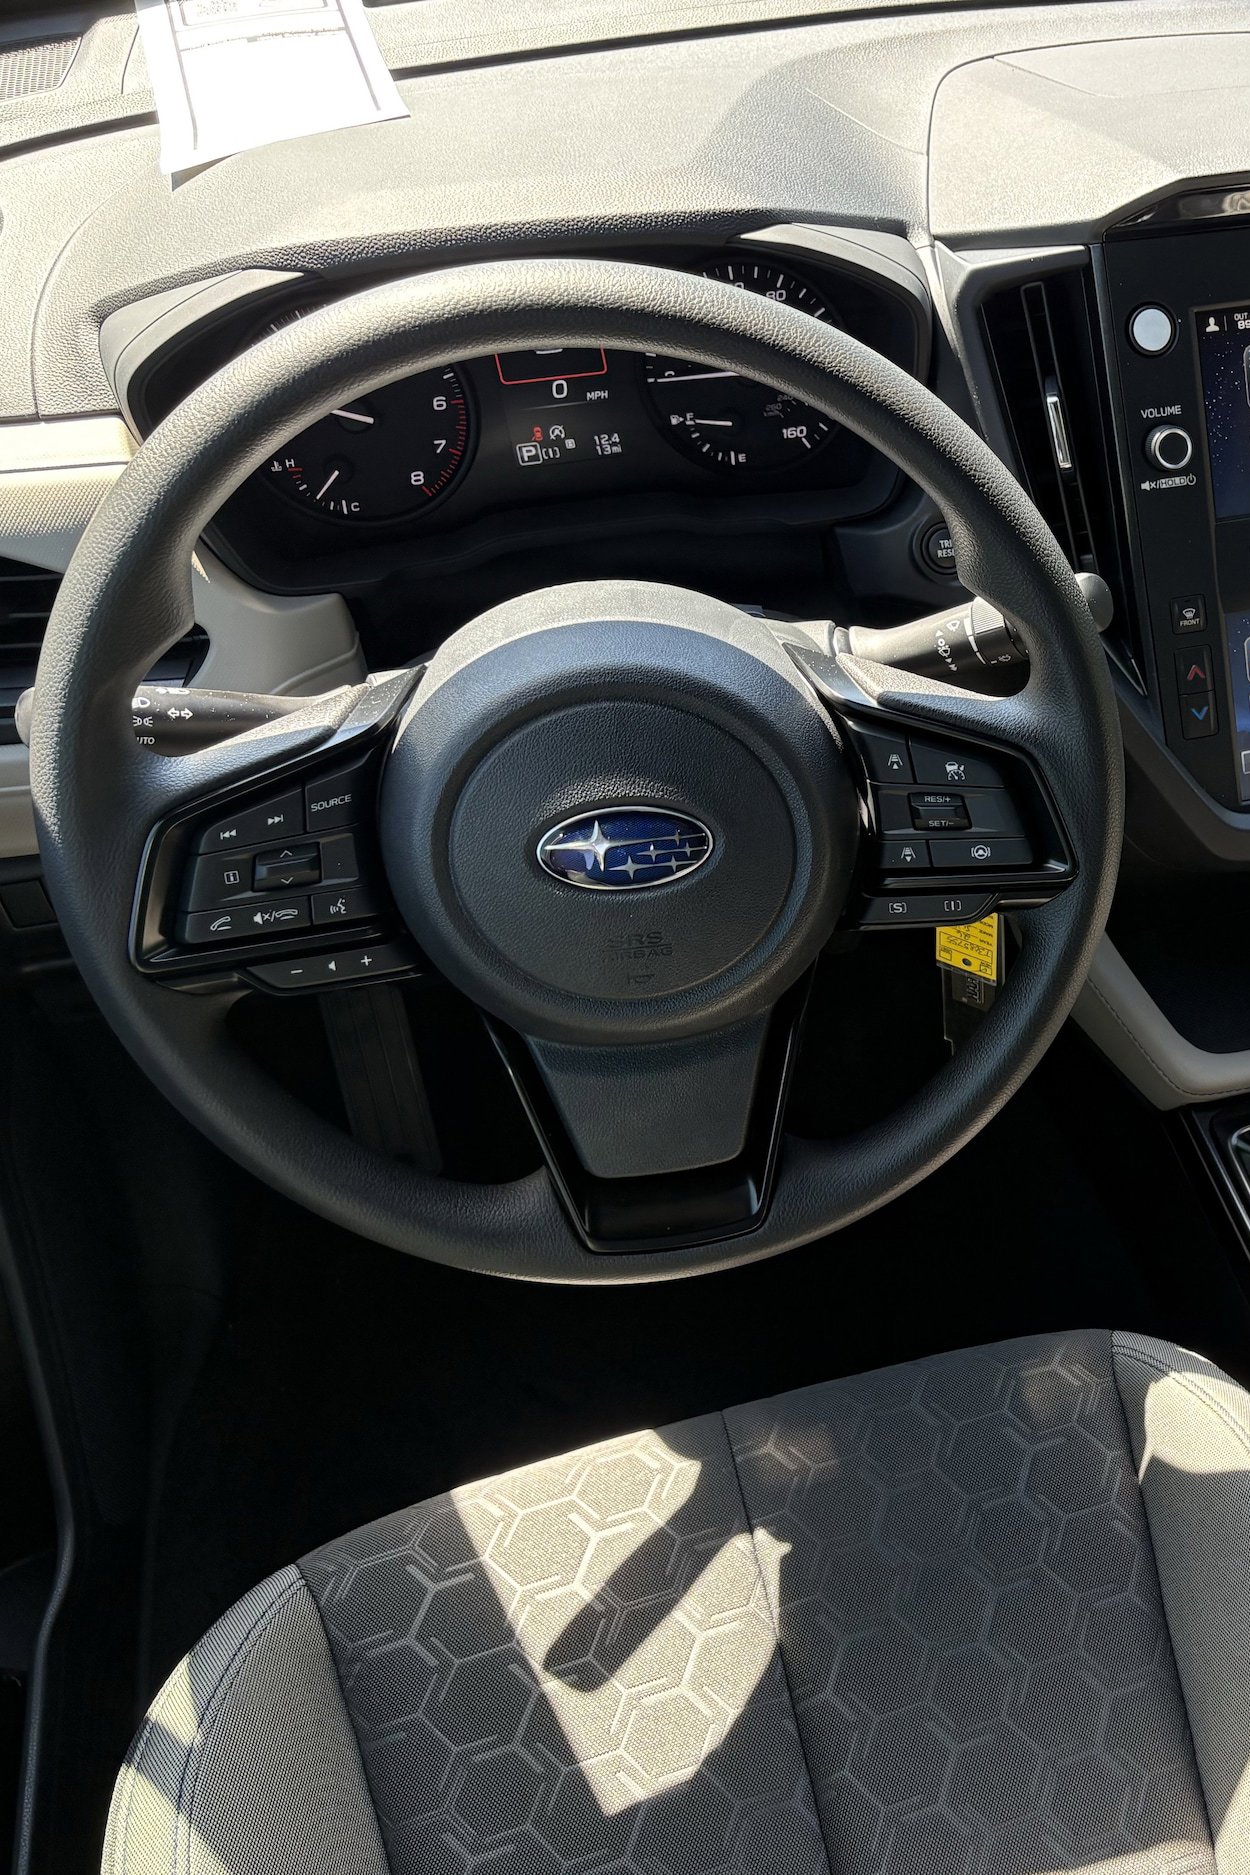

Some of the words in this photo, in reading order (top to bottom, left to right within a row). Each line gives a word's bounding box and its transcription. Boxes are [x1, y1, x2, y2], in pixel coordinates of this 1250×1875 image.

[1233, 312, 1248, 322] OUT
[552, 379, 568, 399] 0
[586, 390, 609, 401] MPH
[432, 395, 447, 411] 6
[685, 412, 695, 421] F
[1140, 405, 1182, 419] VOLUME
[782, 425, 807, 439] 160
[593, 433, 621, 446] 12.4
[433, 439, 447, 454] 7
[285, 458, 296, 469] H
[738, 453, 747, 463] E
[410, 470, 425, 486] 8
[1160, 477, 1187, 488] HOLD
[350, 501, 361, 512] C
[939, 539, 953, 549] TRI
[937, 549, 955, 558] RES
[1179, 618, 1200, 627] FRONT
[137, 736, 156, 745] UTO
[310, 793, 353, 812] SOURCE
